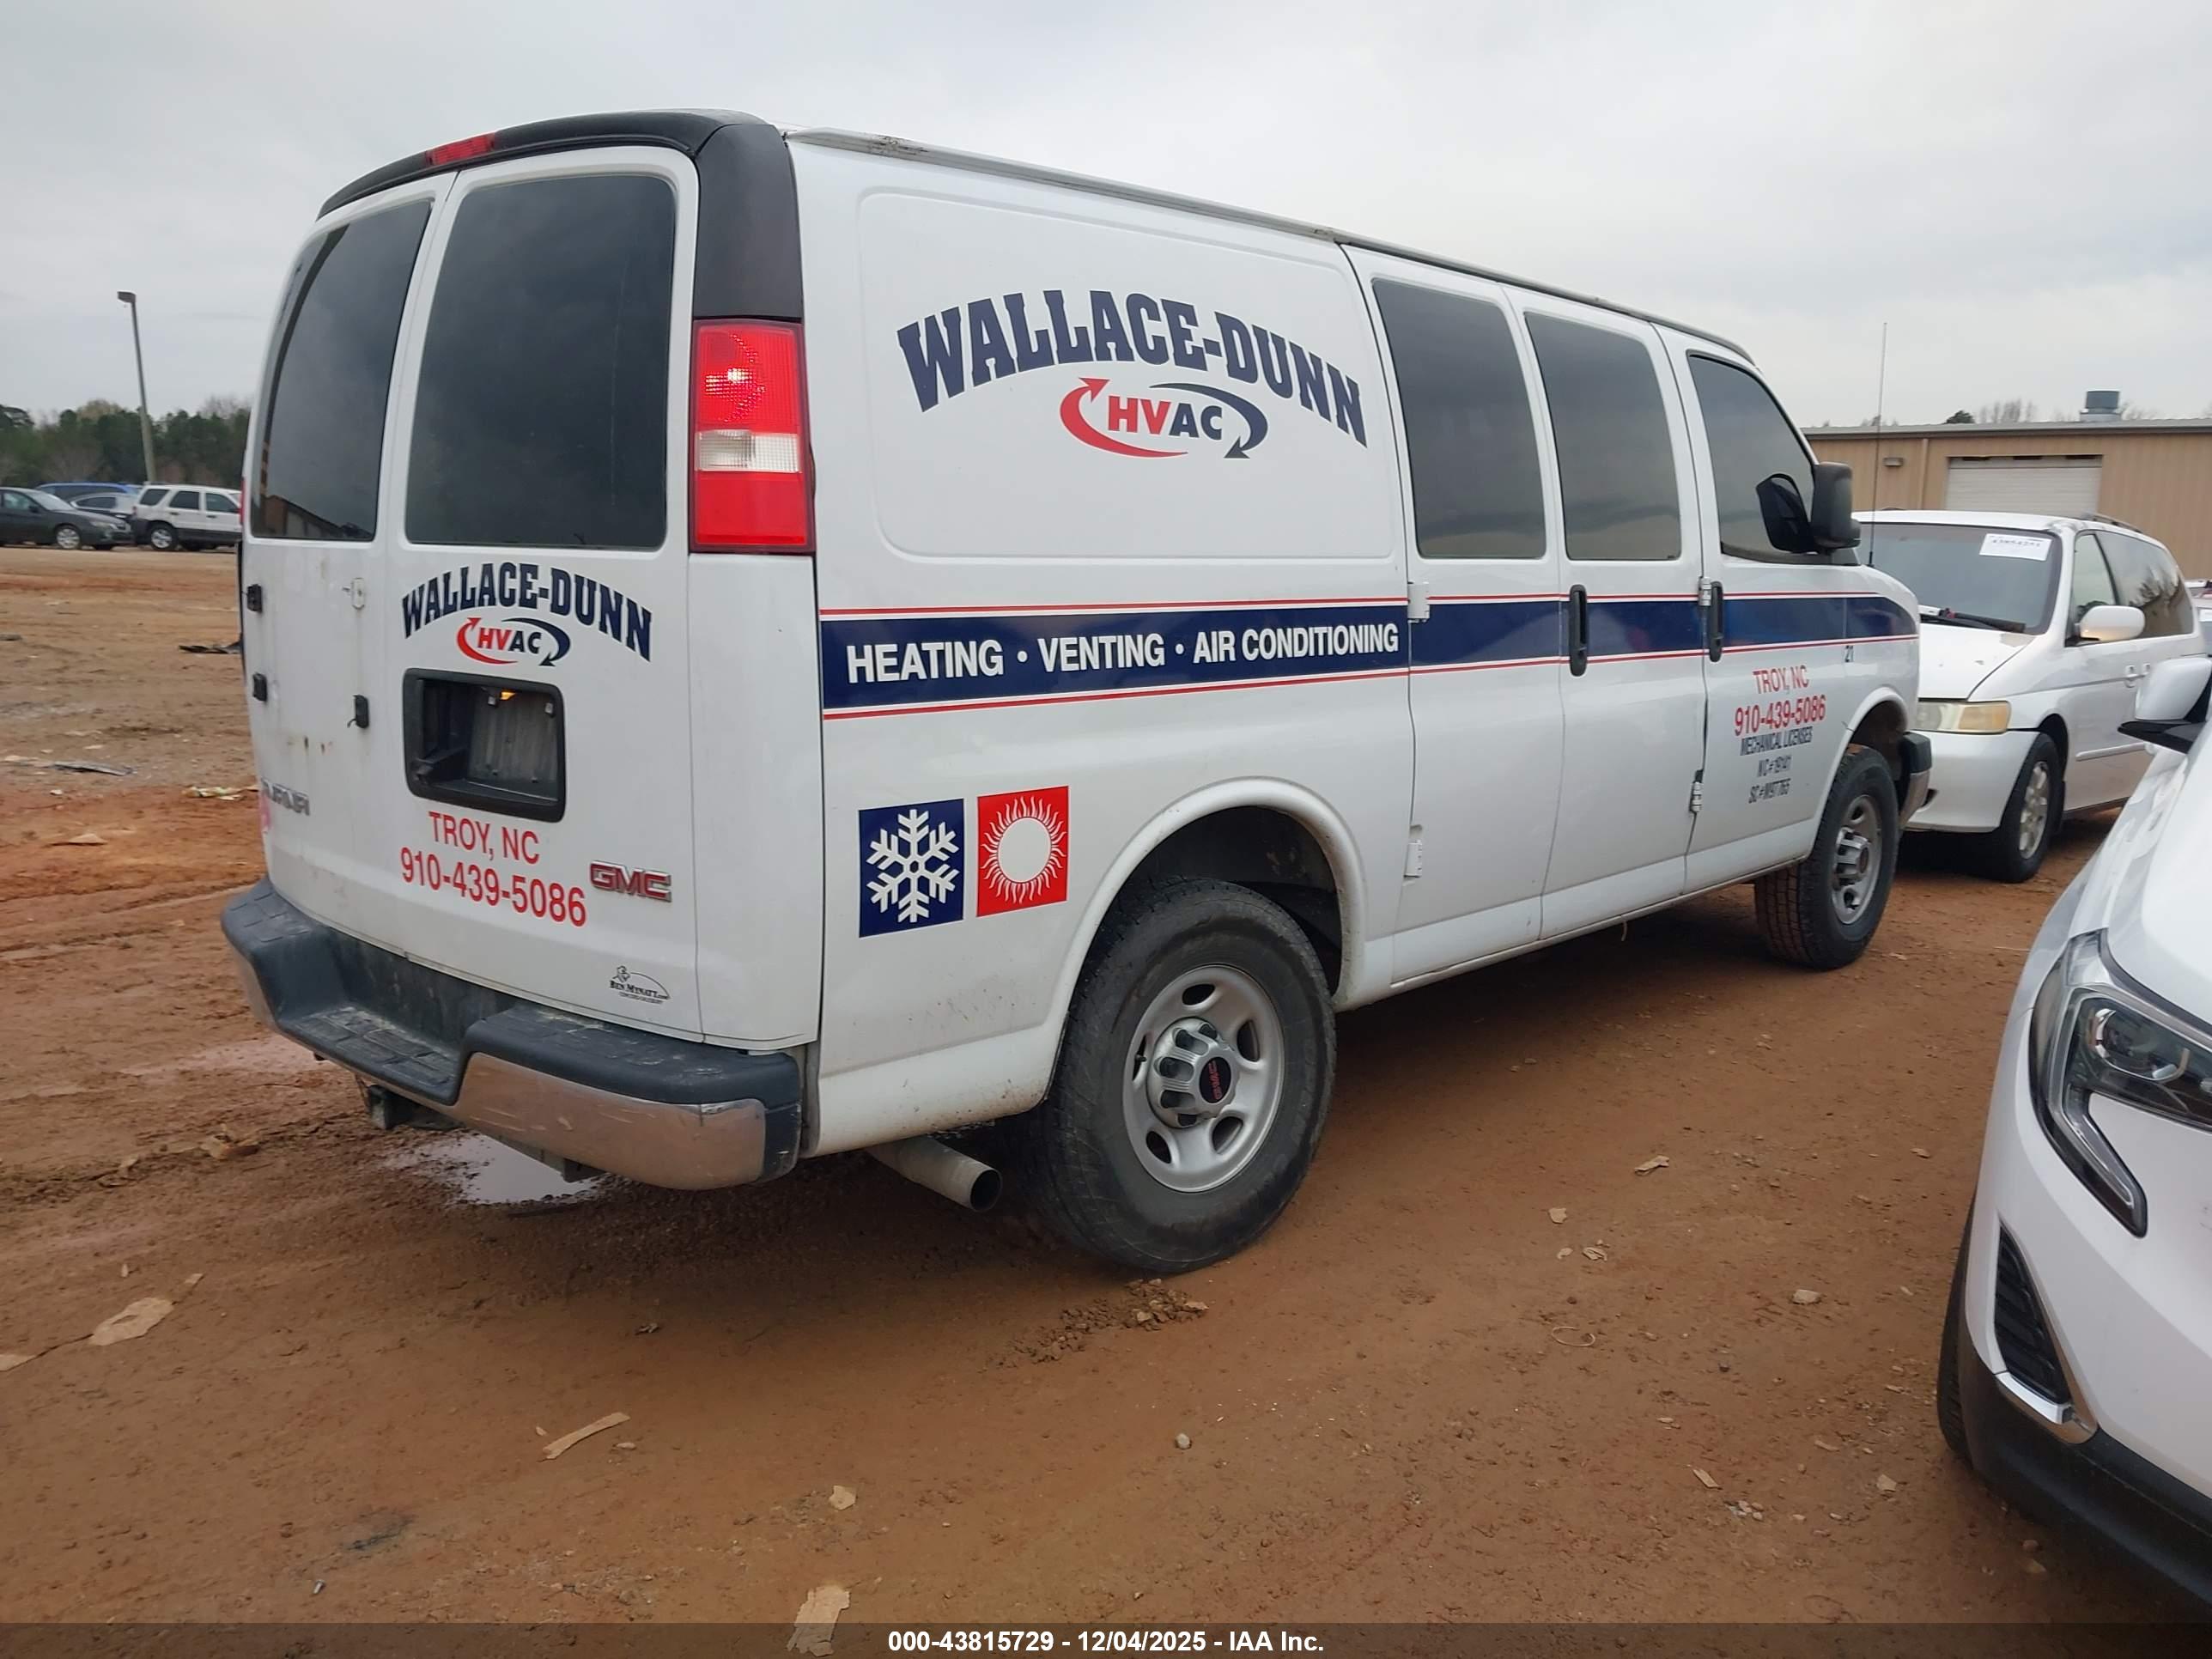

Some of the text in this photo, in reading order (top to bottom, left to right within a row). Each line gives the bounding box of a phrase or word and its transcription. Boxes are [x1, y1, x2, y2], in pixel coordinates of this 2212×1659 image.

[896, 289, 1368, 448] WALLACE-DUNN
[1108, 396, 1223, 441] HVAC
[402, 562, 652, 663] WALLACE-DUNN
[477, 627, 542, 654] HVAC
[847, 623, 1400, 684] HEATING VENTING AIR CONDITIONING
[1791, 665, 1809, 688] NC
[1734, 694, 1826, 736] 910-439-5086
[1740, 732, 1783, 756] MECHANICAL
[428, 811, 539, 864] TROY, NC
[400, 847, 586, 927] 910-439-5086
[590, 860, 672, 902] GMC
